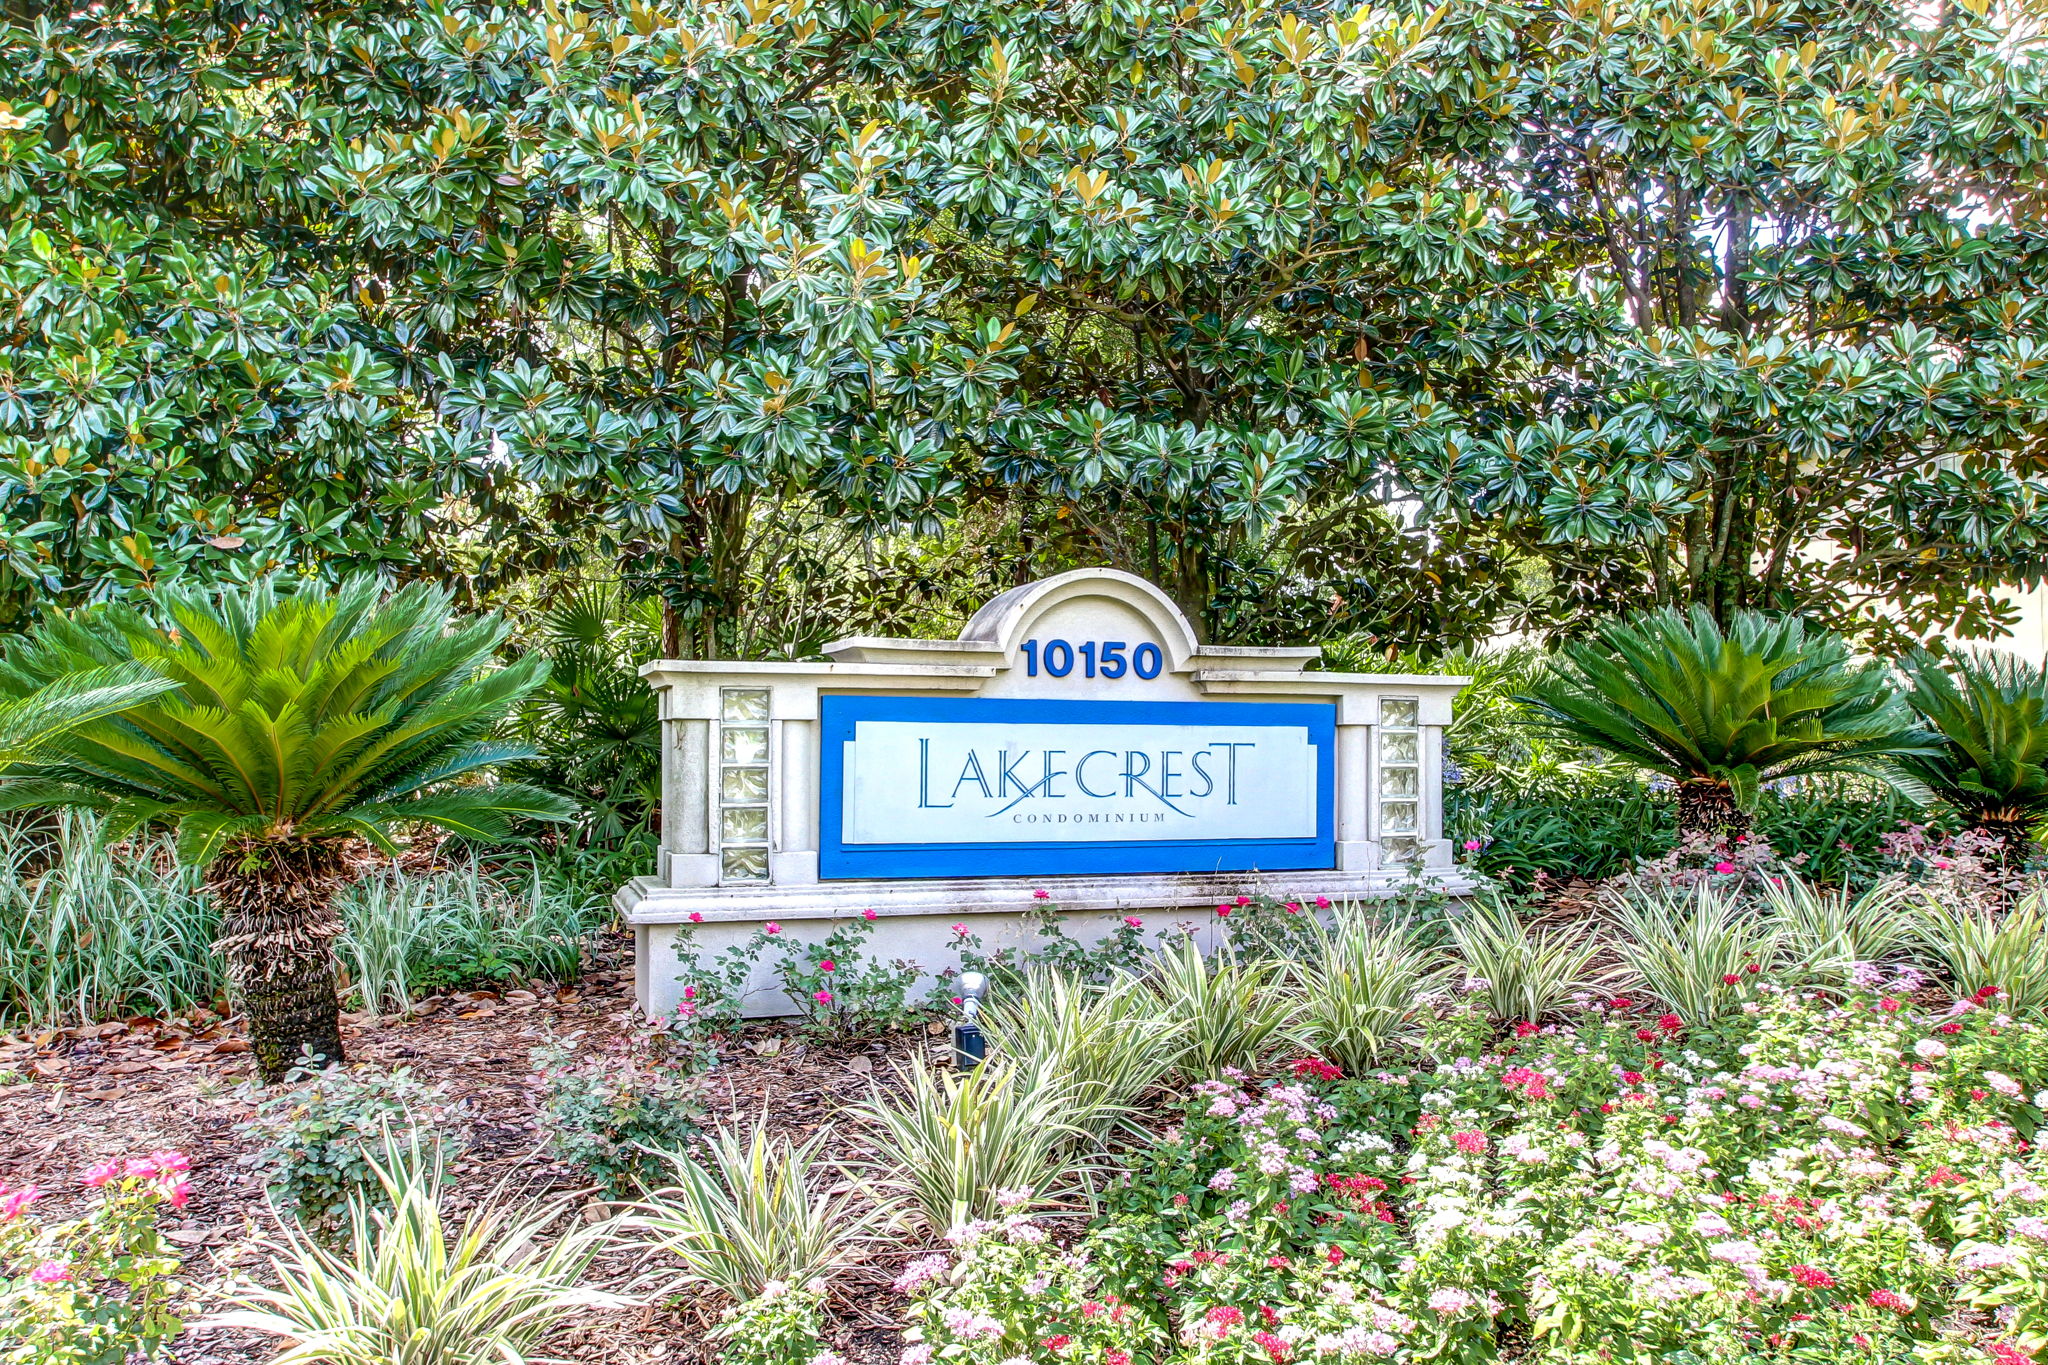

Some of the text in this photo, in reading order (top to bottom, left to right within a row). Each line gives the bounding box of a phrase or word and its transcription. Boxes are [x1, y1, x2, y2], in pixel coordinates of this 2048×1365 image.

[1021, 639, 1163, 680] 10150
[917, 738, 1256, 817] LAKECREST
[1013, 813, 1166, 824] CONDOMINIUM
